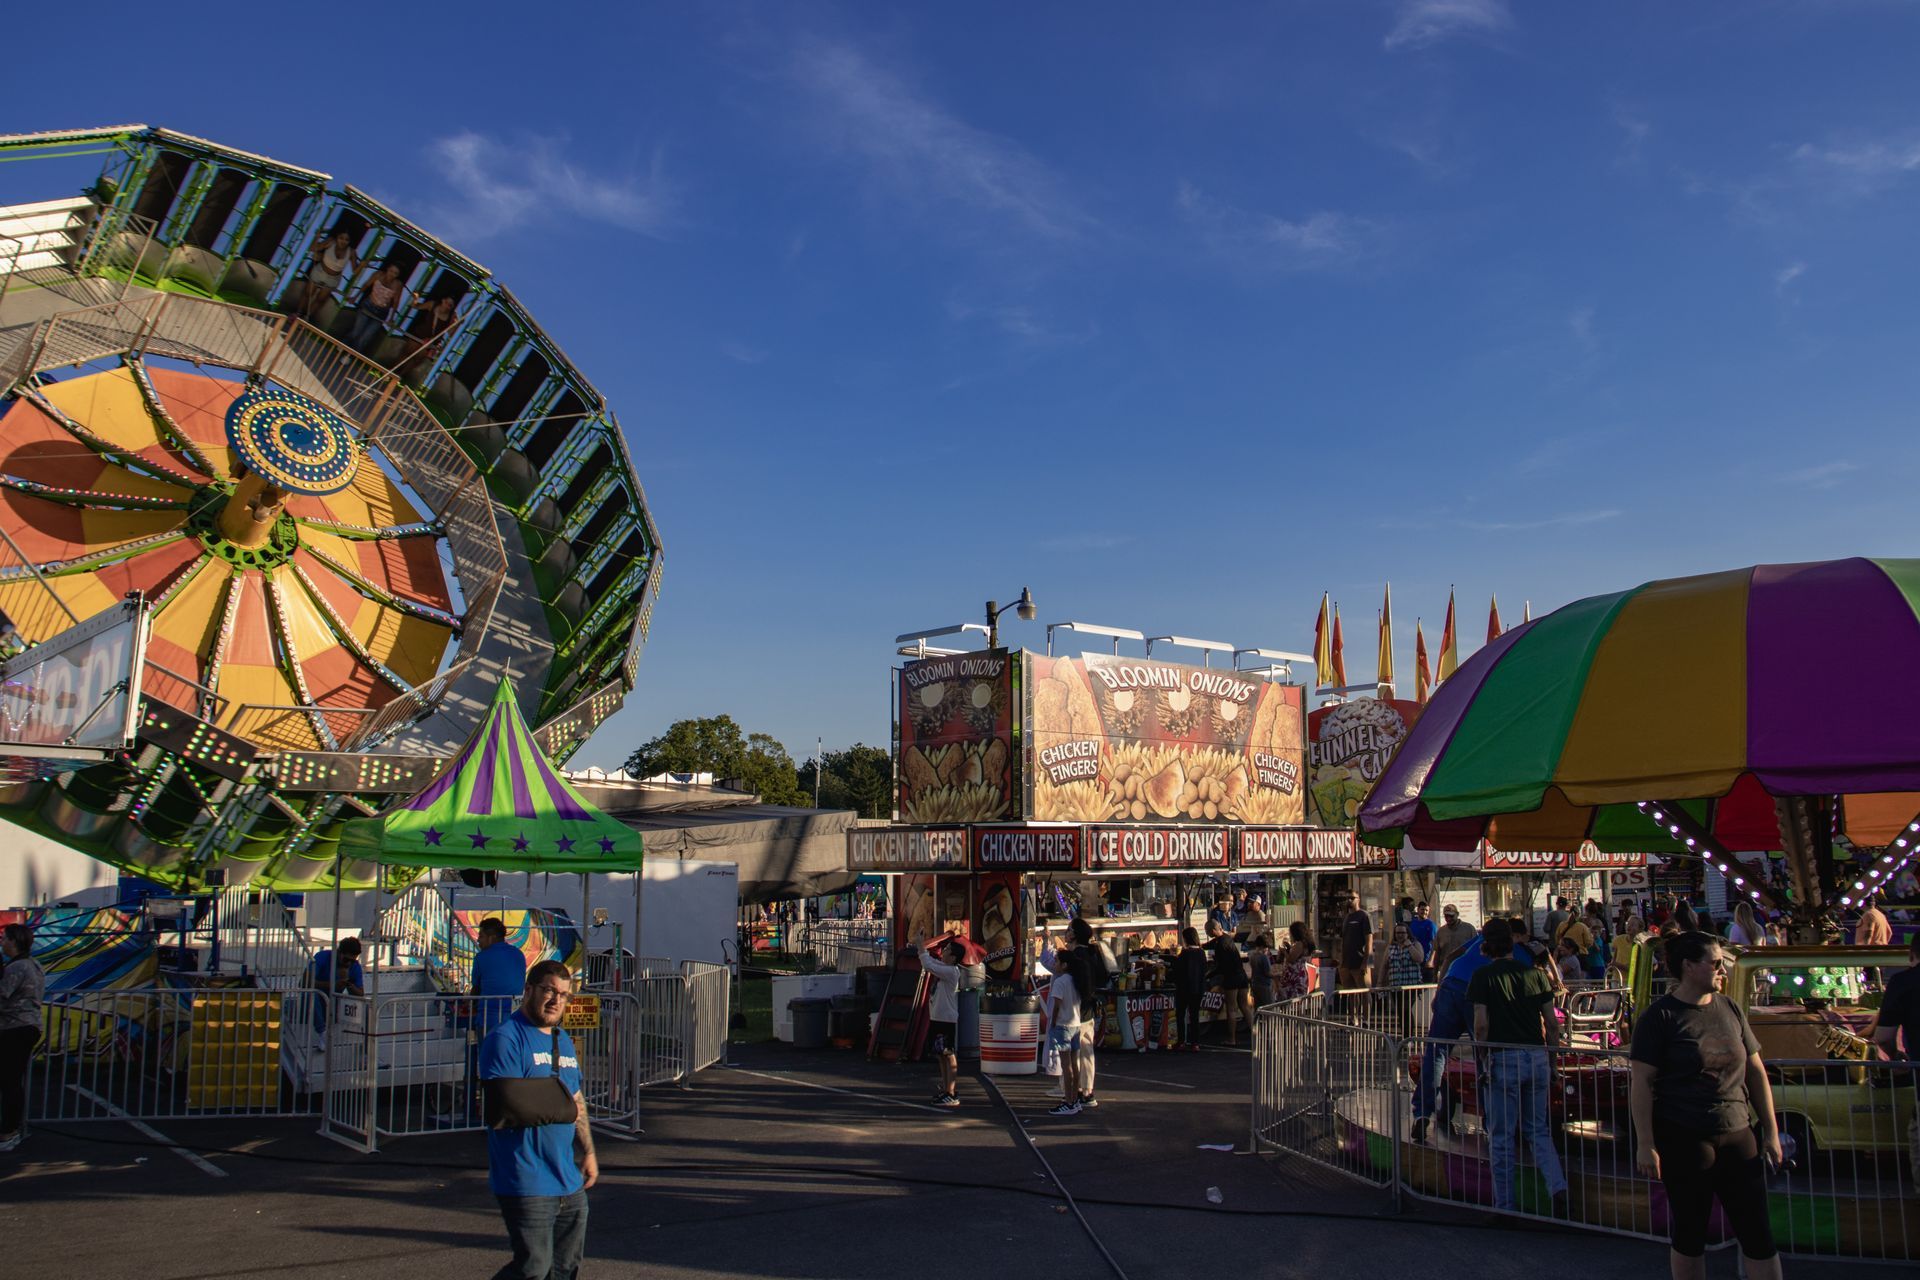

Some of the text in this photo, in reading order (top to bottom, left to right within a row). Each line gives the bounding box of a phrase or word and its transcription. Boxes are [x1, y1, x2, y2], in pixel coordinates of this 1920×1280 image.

[906, 659, 1005, 687] BLOOMIN ONIONS
[1098, 665, 1256, 702] BLOOMIN ONIONS
[1041, 740, 1099, 766] CHICKEN
[1309, 724, 1380, 767] FUNNEL
[1049, 759, 1098, 783] FINGERS
[1254, 752, 1297, 778] CHICKEN
[1360, 741, 1400, 780] CAK
[1258, 769, 1294, 792] FINGERS
[853, 832, 963, 862] CHICKEN FINGERS
[981, 833, 1074, 862] CHICKEN FRIES
[1091, 831, 1224, 862] ICE COLD DRINKS
[1245, 832, 1352, 859] BLOOMIN ONIONS
[344, 1004, 357, 1017] EXIT
[600, 998, 620, 1011] NTER
[1125, 995, 1175, 1013] CONDIMEN
